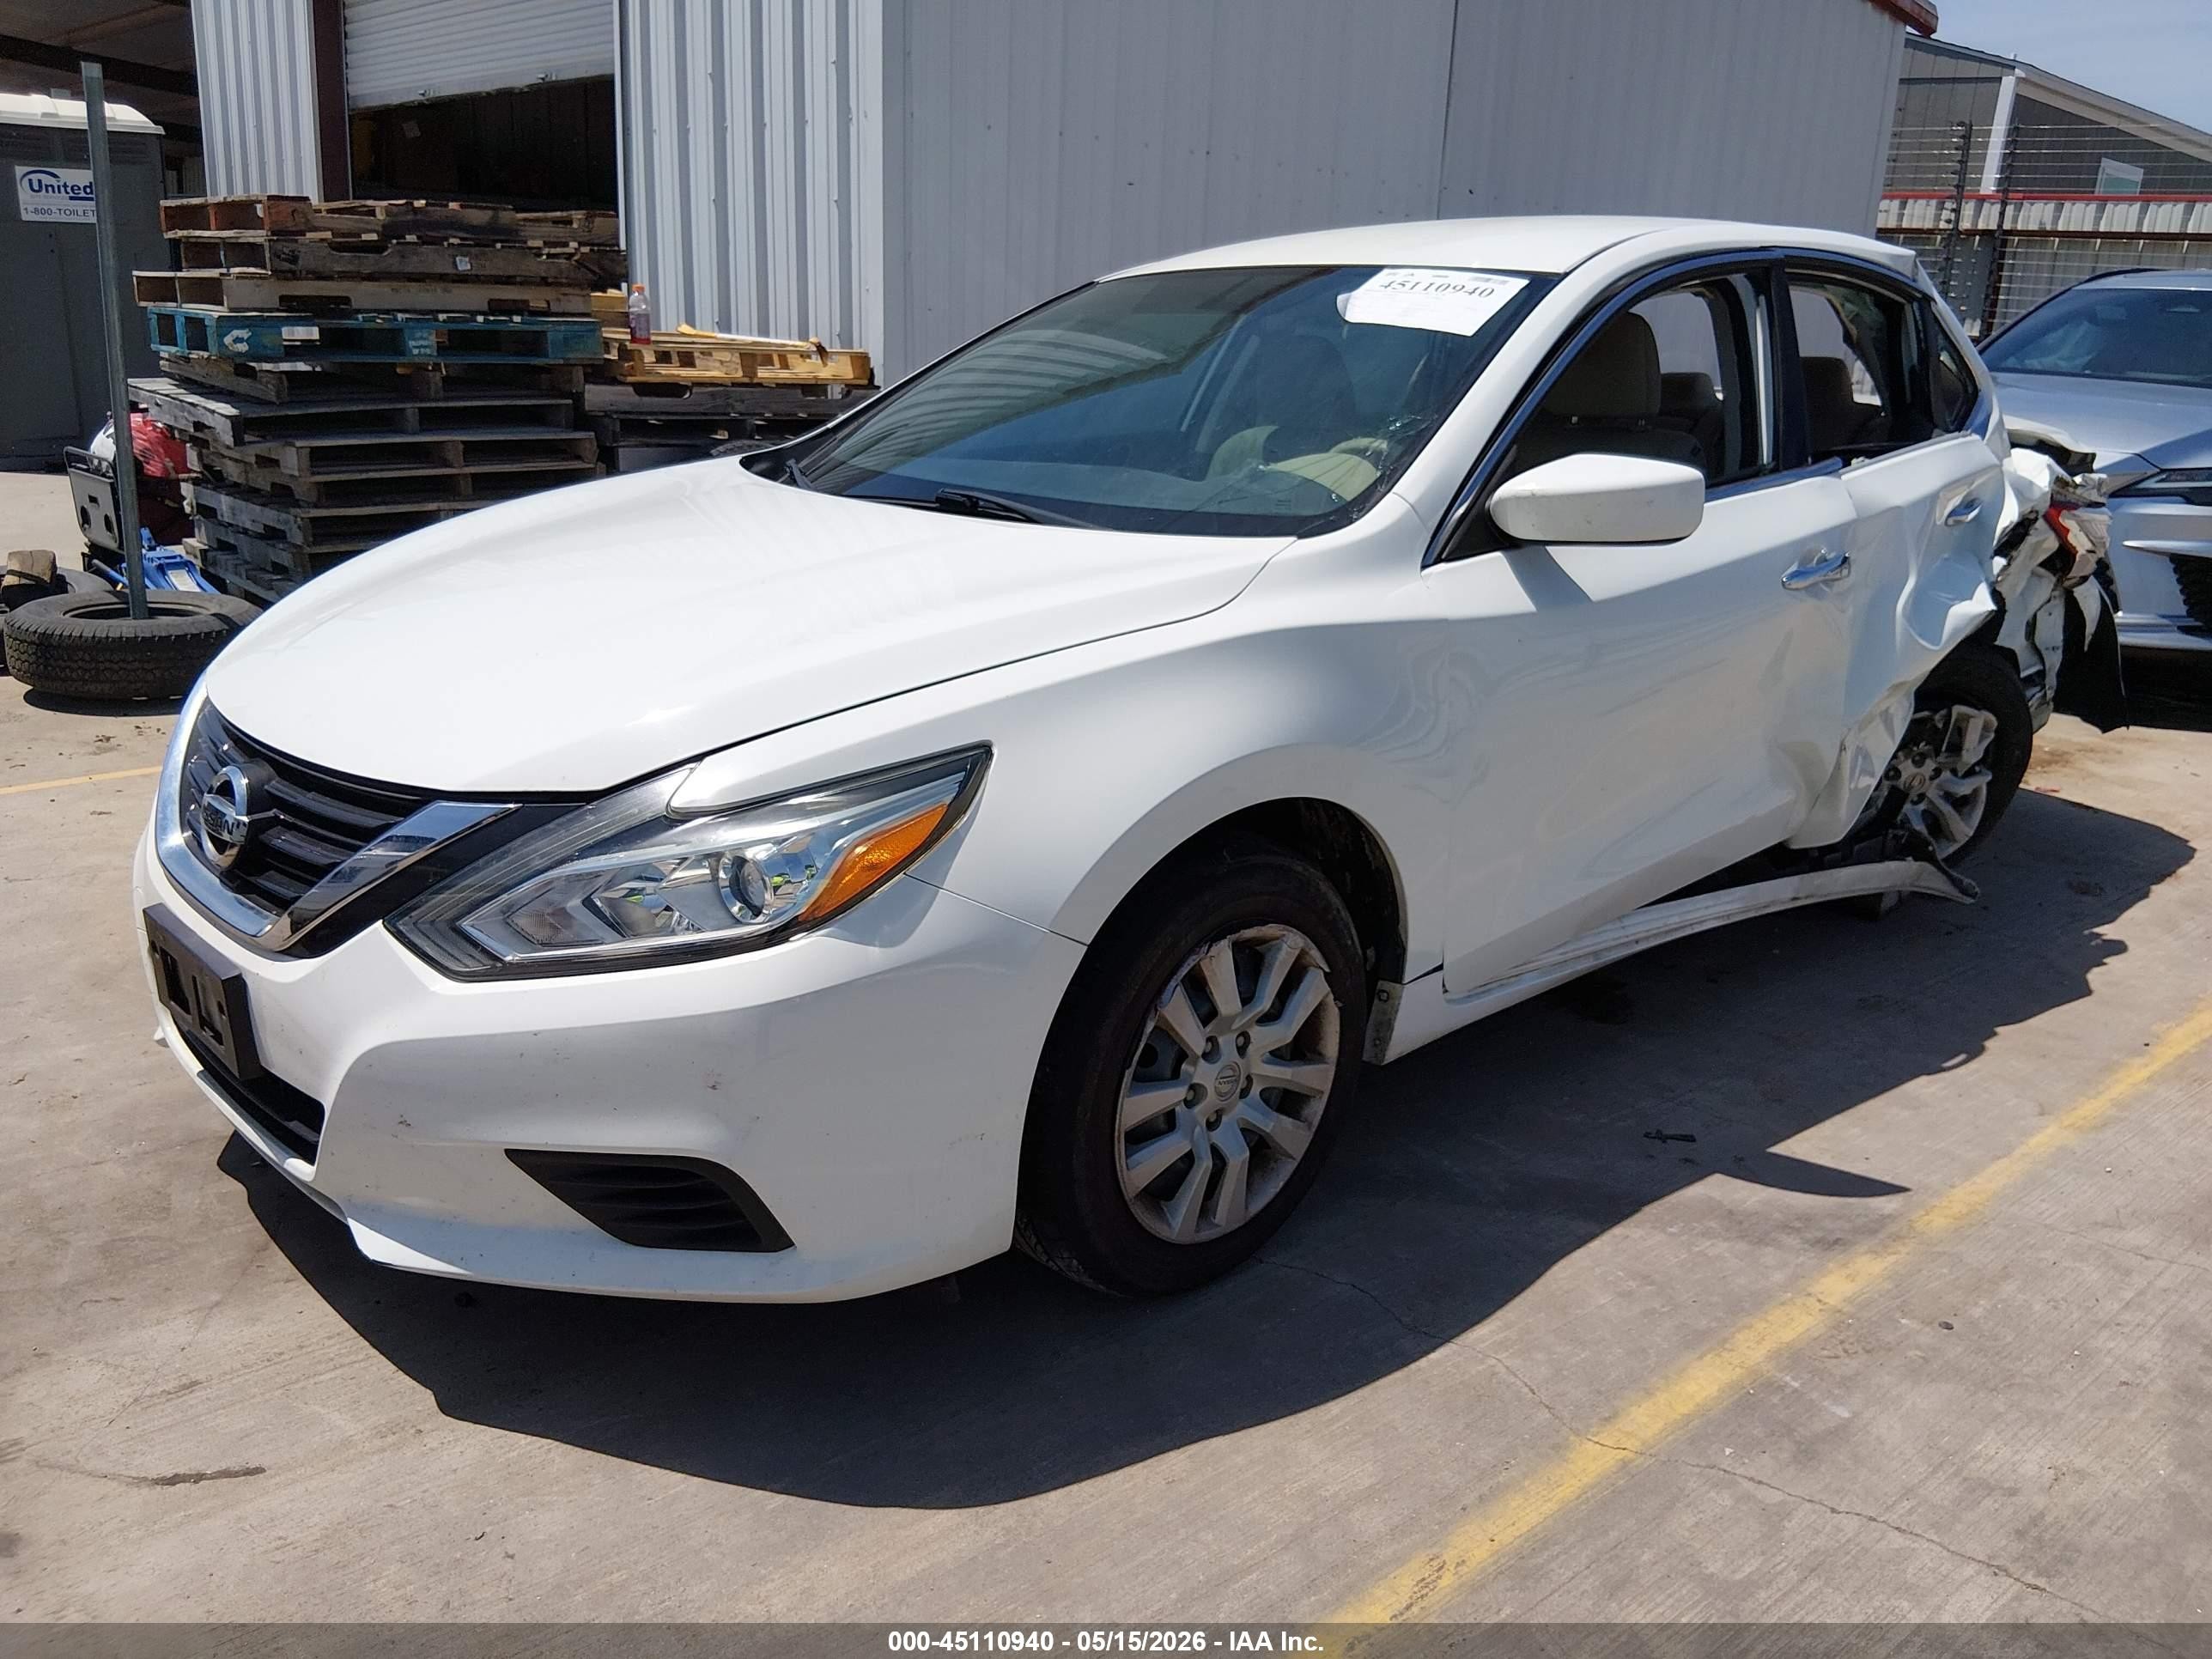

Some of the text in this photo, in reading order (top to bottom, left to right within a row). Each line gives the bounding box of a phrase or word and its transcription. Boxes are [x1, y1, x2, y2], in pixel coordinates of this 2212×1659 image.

[28, 178, 94, 196] United
[23, 207, 96, 217] 1-800-TOILET
[1380, 279, 1495, 299] 45110940
